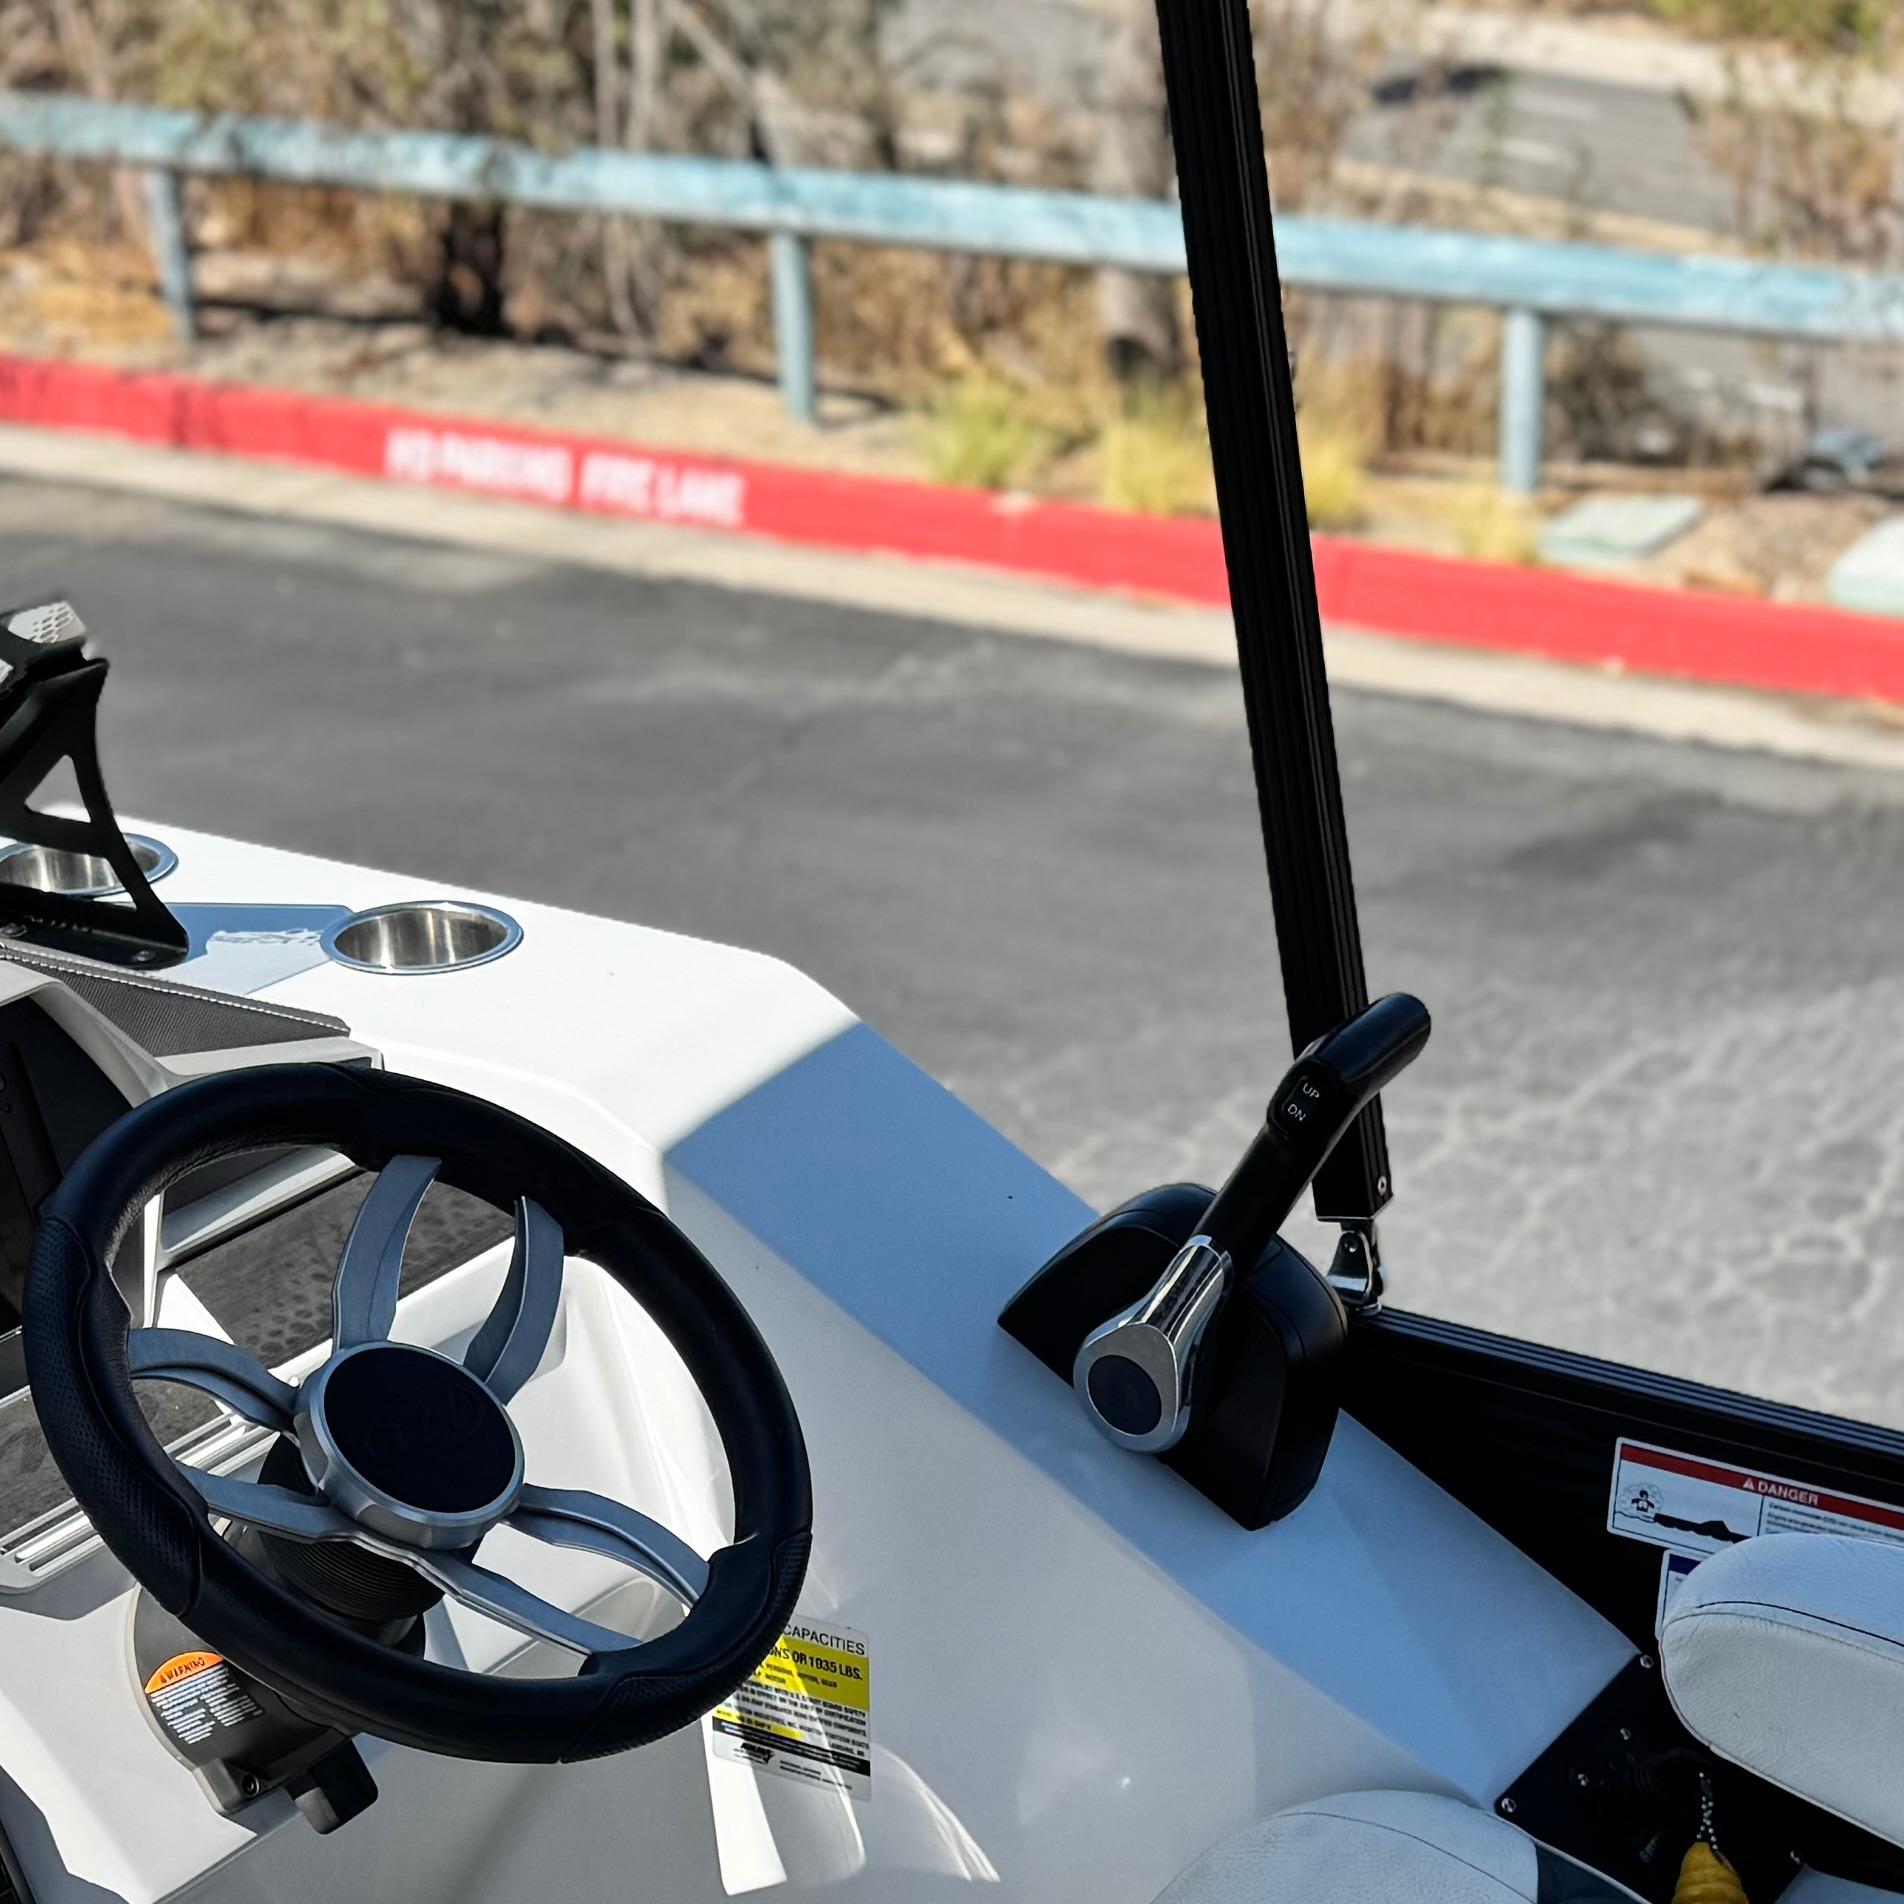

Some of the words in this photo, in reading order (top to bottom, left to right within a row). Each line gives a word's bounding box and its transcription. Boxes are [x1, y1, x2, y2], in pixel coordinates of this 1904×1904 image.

[1302, 1083, 1320, 1098] UP
[1287, 1103, 1306, 1121] DN
[1758, 1480, 1819, 1506] DANGER
[783, 1624, 865, 1656] CAPACITIES
